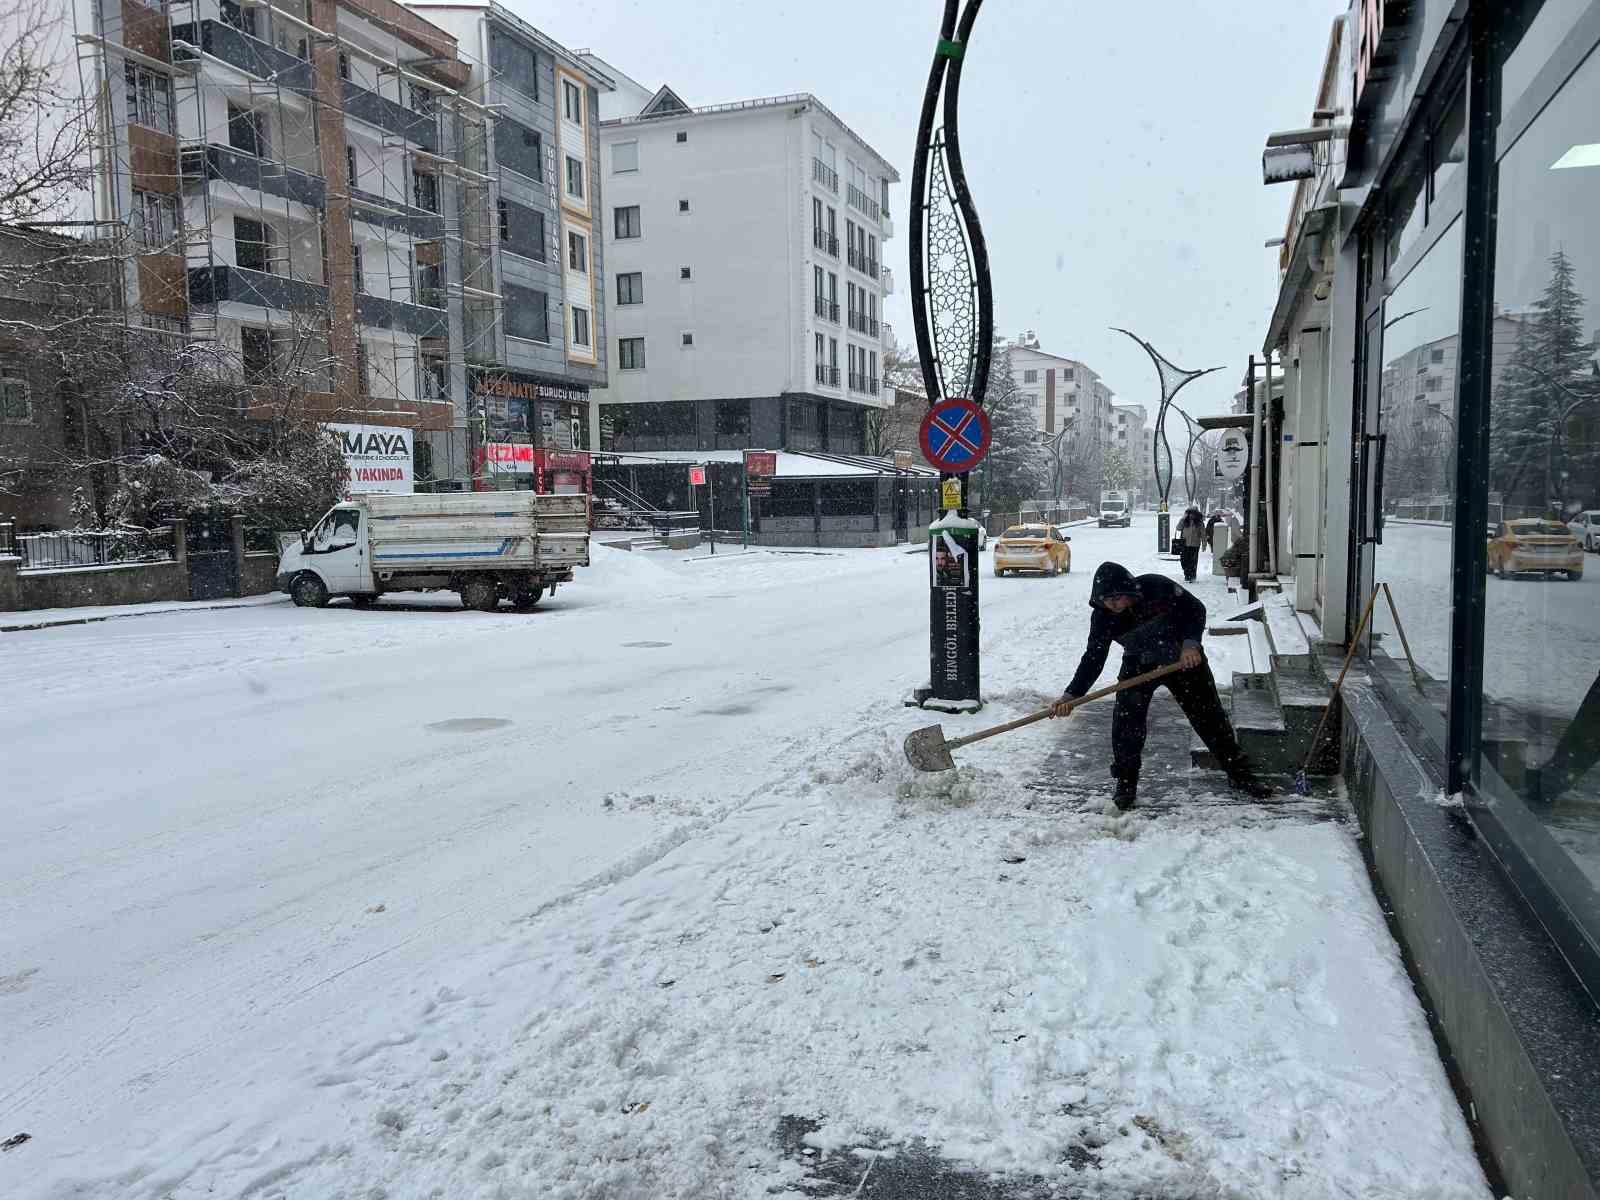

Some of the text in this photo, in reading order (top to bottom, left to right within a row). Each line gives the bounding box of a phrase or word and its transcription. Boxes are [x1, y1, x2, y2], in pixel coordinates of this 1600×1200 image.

[355, 468, 403, 482] YAKINDA
[942, 586, 957, 631] BELEDİ
[943, 633, 958, 681] BİNGÖL
